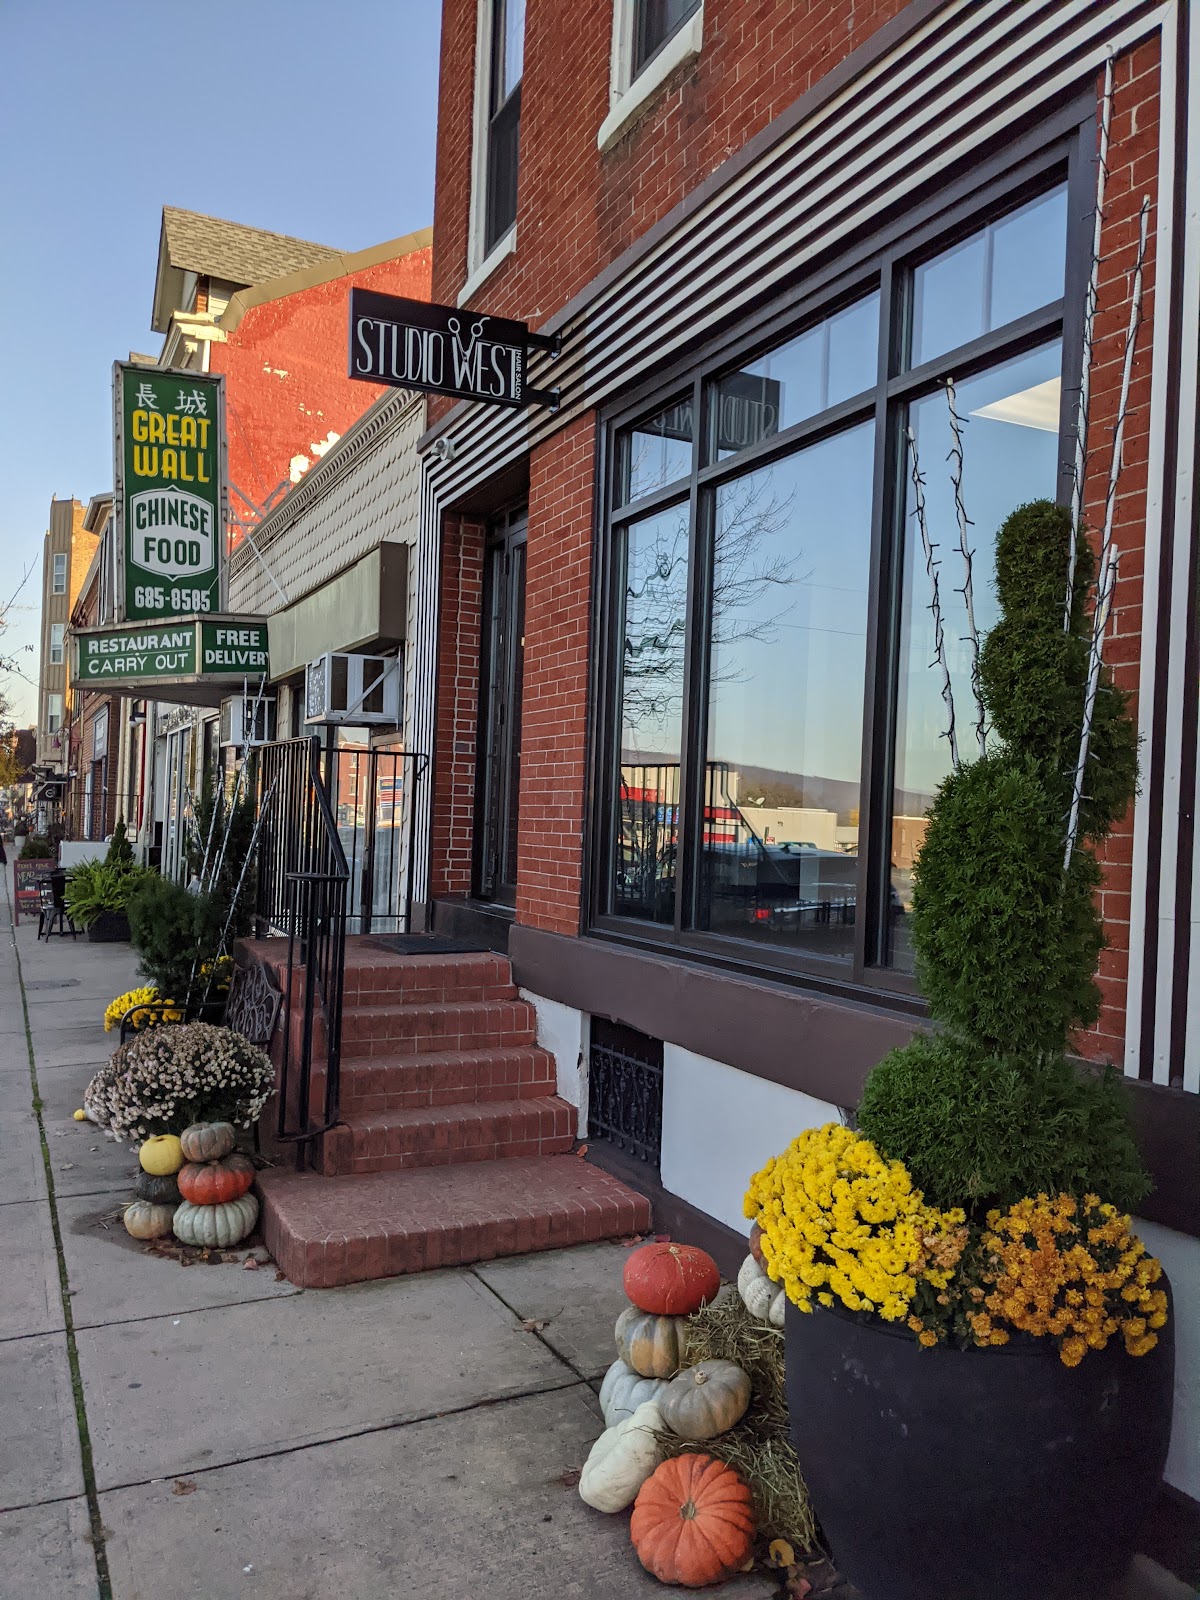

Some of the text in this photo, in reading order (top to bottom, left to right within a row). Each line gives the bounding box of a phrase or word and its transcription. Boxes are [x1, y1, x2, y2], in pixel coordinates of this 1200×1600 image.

[356, 318, 522, 399] STUDIO WEST
[132, 409, 212, 450] GREAT
[133, 444, 211, 483] WALL
[136, 497, 209, 538] CHINESE
[144, 536, 201, 567] FOOD
[134, 586, 211, 612] 685-8585
[88, 631, 193, 654] RESTAURANT
[216, 629, 260, 647] FREE
[88, 652, 189, 675] CARRY OUT
